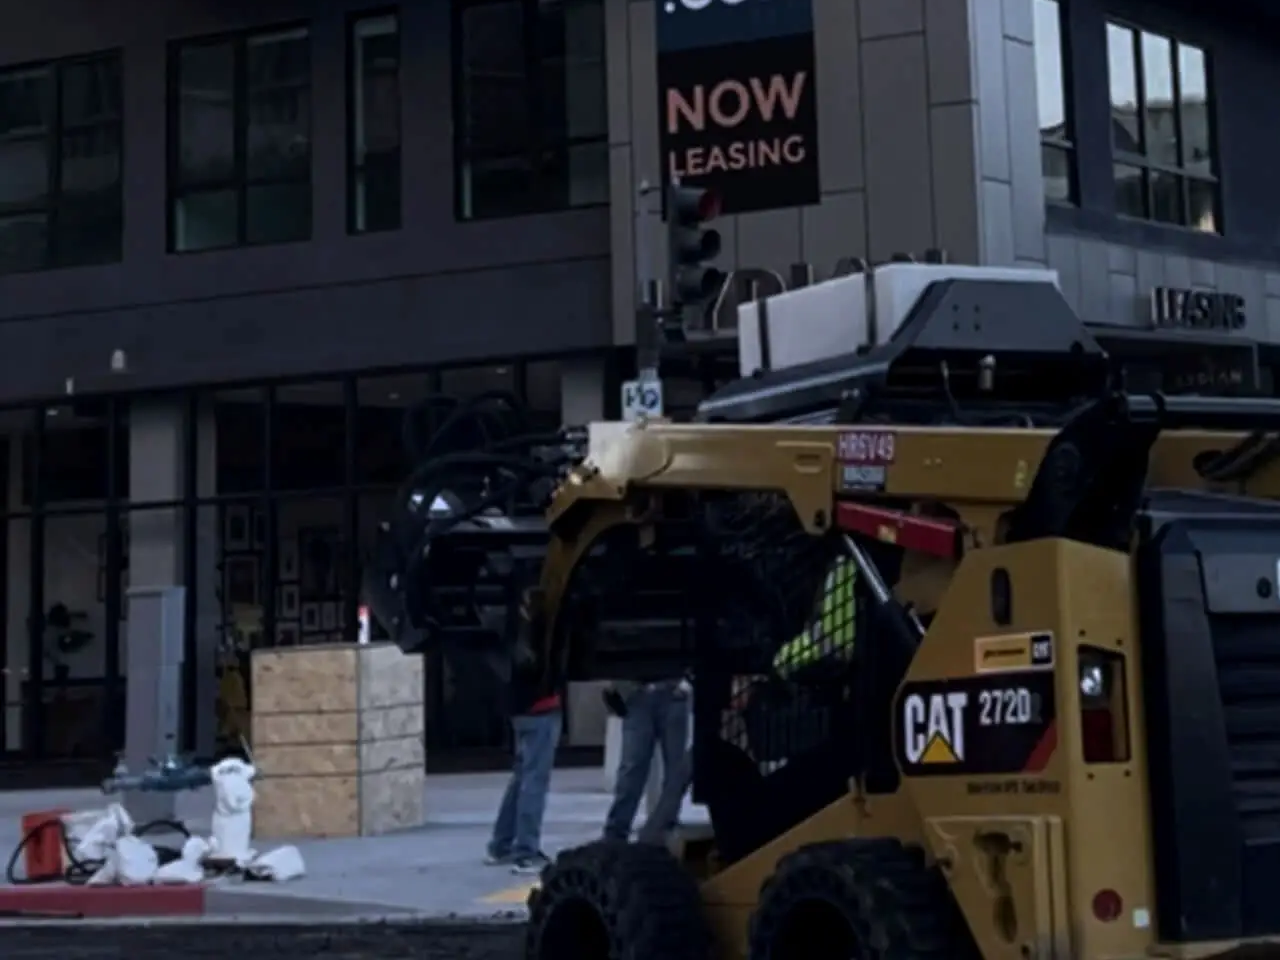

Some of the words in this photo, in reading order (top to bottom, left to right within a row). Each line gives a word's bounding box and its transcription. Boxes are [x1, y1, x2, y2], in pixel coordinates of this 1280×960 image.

[666, 71, 806, 134] NOW
[669, 134, 806, 176] LEASING
[904, 692, 968, 764] CAT
